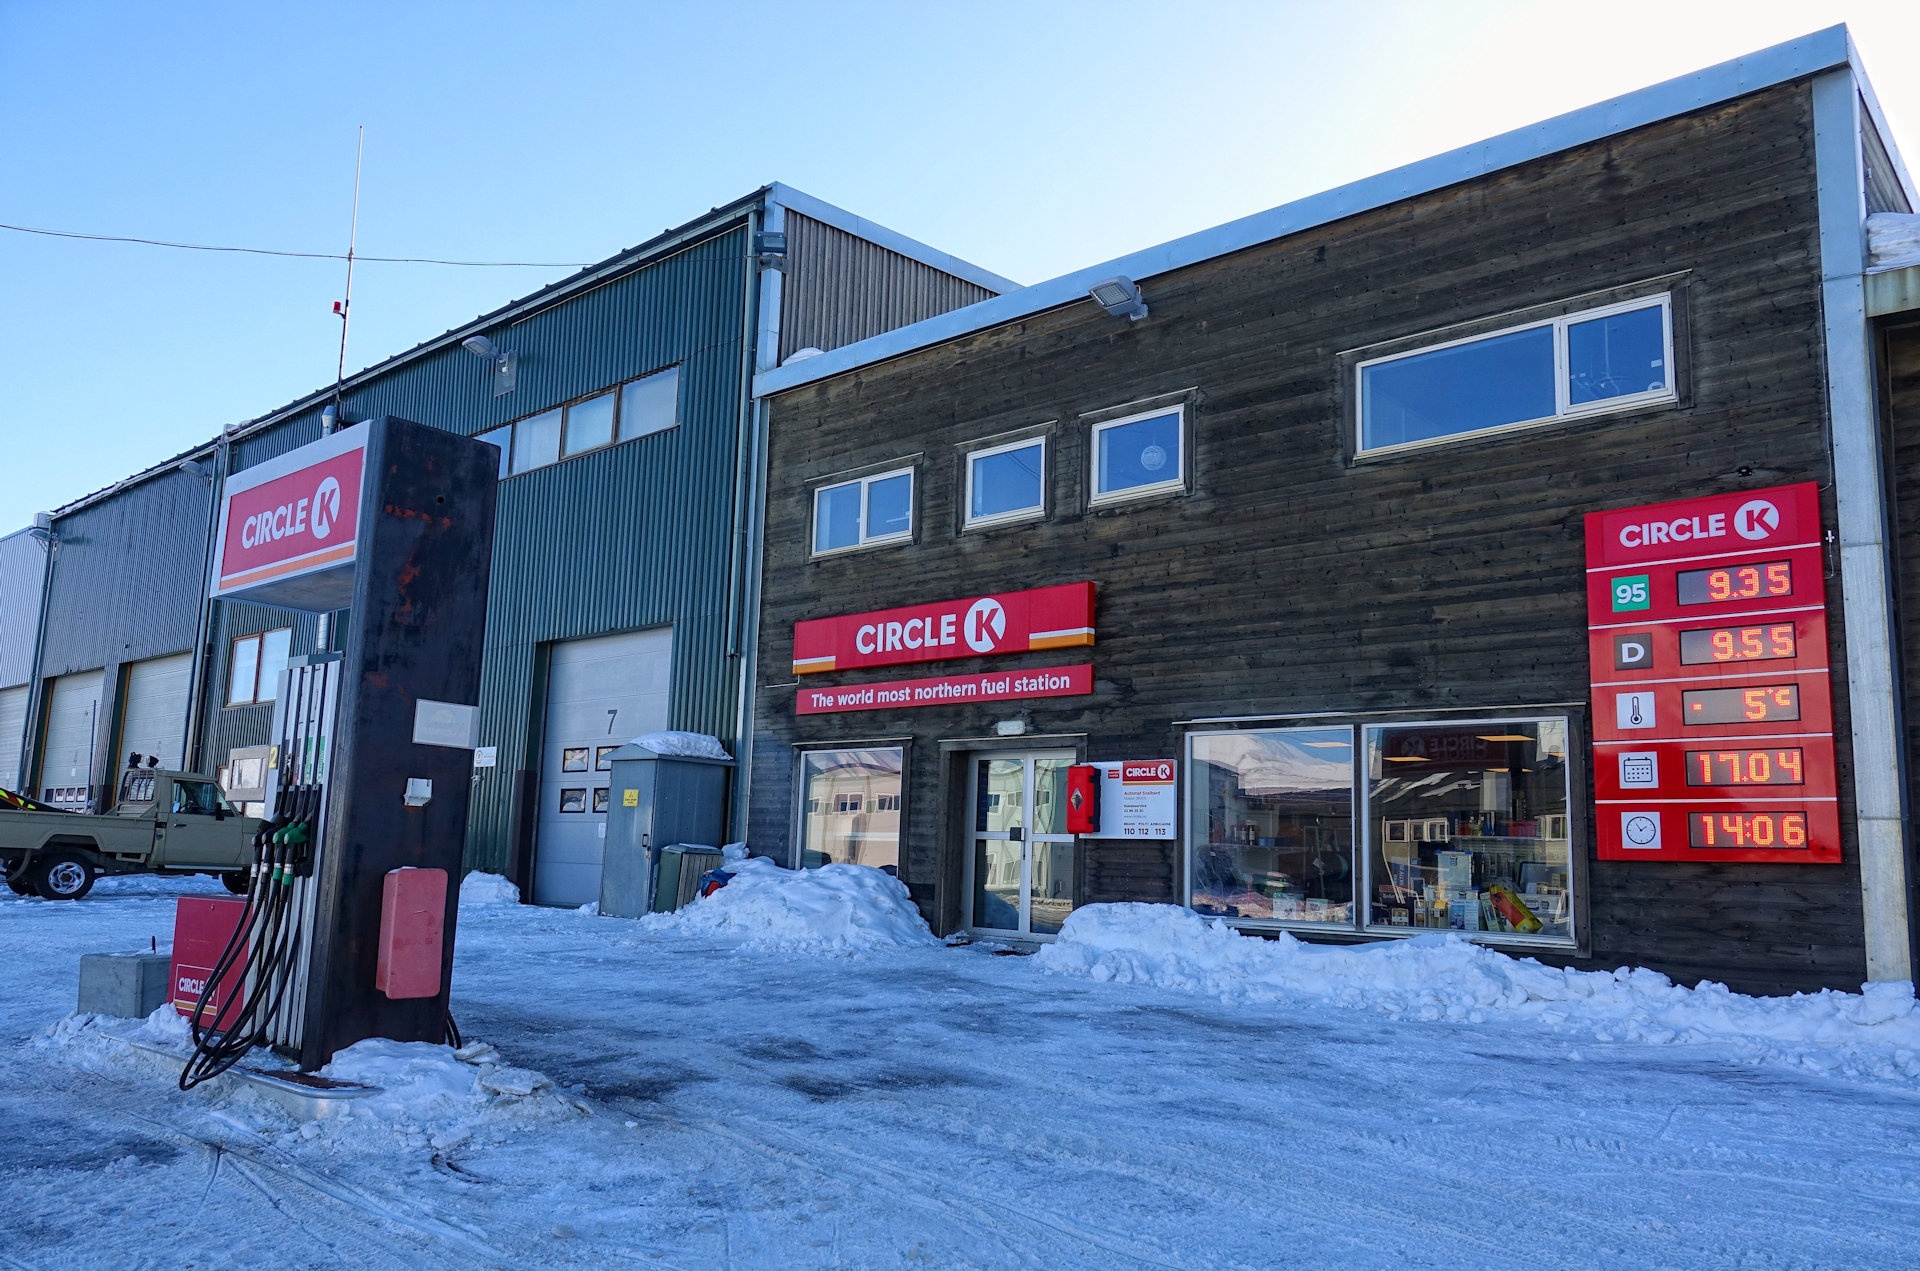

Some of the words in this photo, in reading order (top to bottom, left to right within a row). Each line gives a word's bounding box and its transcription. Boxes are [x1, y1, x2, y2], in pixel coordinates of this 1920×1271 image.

[242, 497, 309, 550] CIRCLE
[315, 483, 338, 535] K
[1619, 512, 1727, 548] CIRCLE
[1741, 504, 1776, 538] K
[1616, 582, 1647, 604] 95
[1708, 564, 1792, 601] 9.35
[856, 613, 957, 655] CIRCLE
[970, 603, 1003, 651] K
[1621, 642, 1645, 663] D
[1711, 625, 1794, 661] 9.55
[812, 693, 834, 708] The
[837, 688, 874, 706] world
[877, 685, 911, 703] most
[914, 681, 977, 700] northern
[981, 677, 1010, 694] fuel
[1014, 673, 1070, 692] station
[607, 709, 618, 735] 7
[268, 745, 279, 769] 2
[1126, 767, 1156, 777] CIRCLE
[1159, 765, 1169, 779] K
[1698, 751, 1802, 783] 17.04
[1702, 815, 1806, 846] 14:06
[178, 977, 205, 995] CIRCLE
